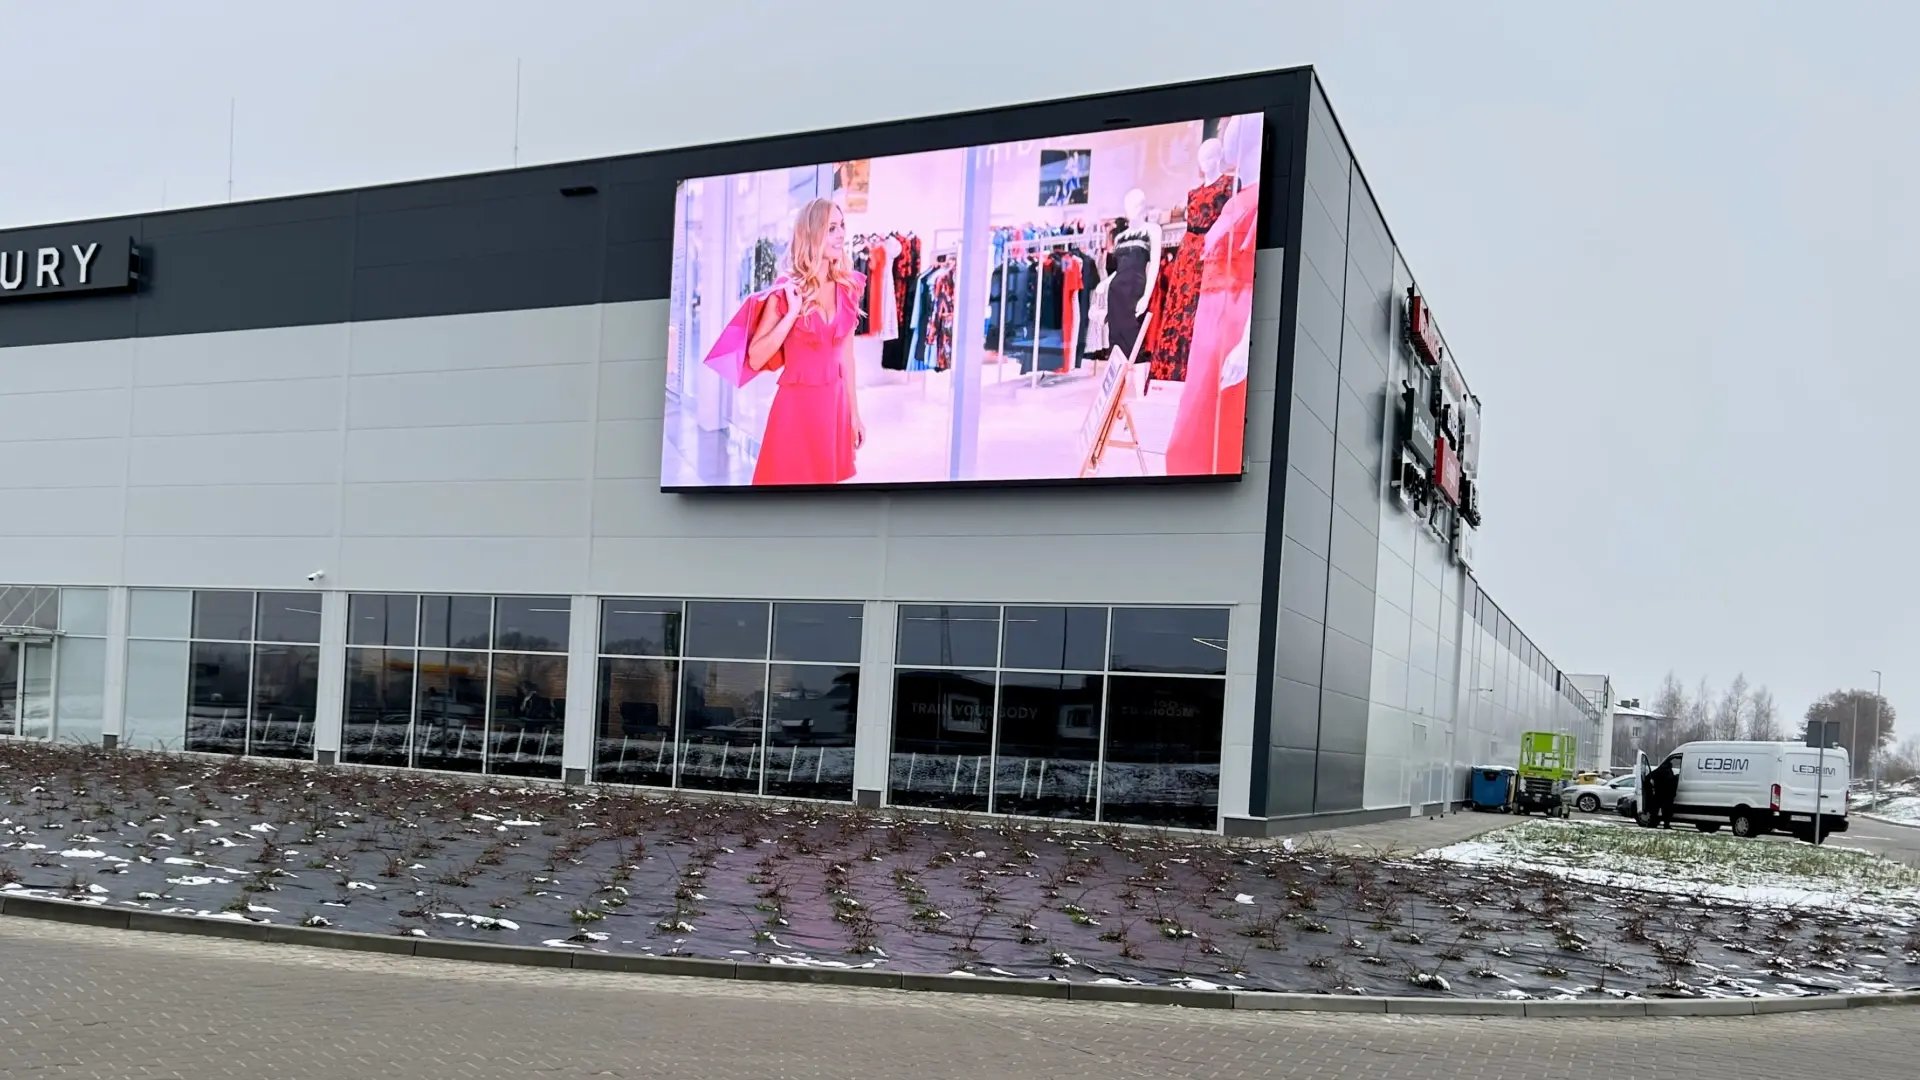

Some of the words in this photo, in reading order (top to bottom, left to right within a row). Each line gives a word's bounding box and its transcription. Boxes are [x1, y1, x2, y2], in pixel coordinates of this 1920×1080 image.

[0, 242, 98, 290] URY
[954, 704, 993, 718] YOUR
[1697, 757, 1749, 771] LEDBIM
